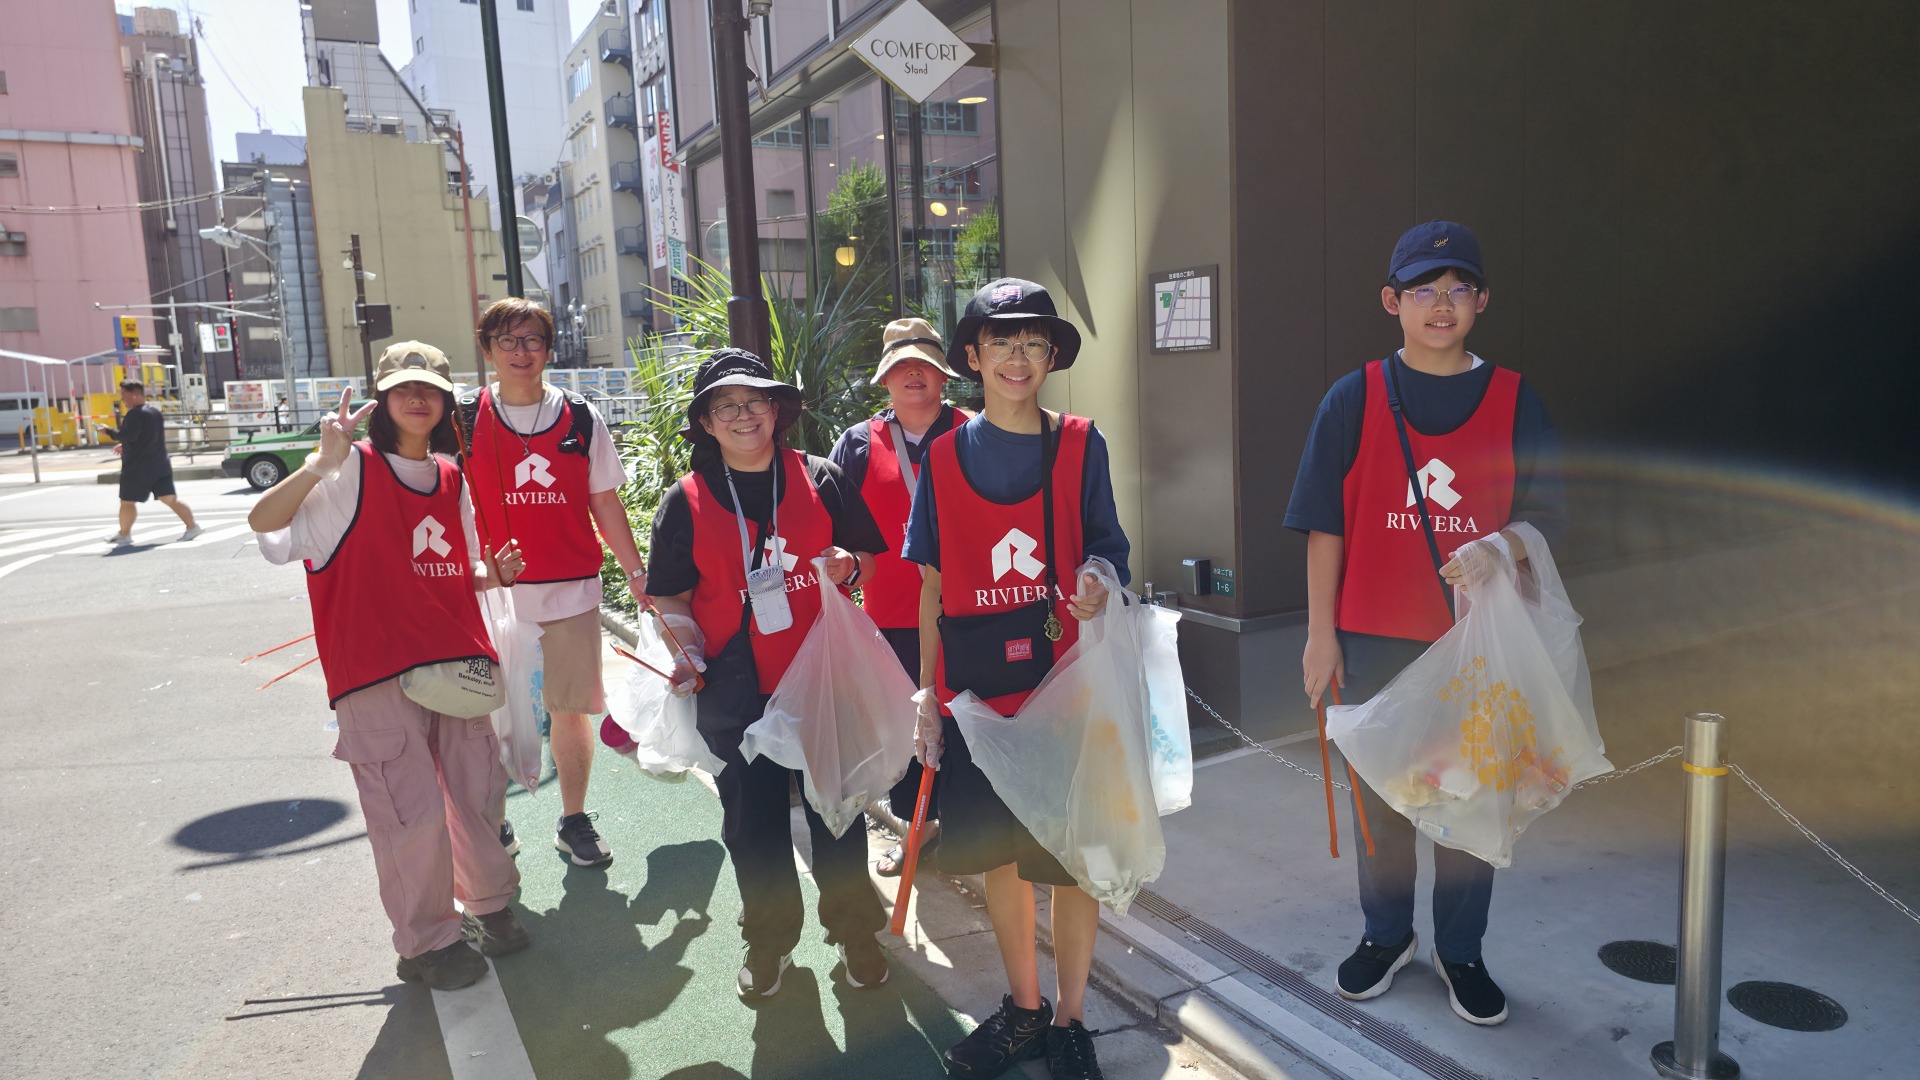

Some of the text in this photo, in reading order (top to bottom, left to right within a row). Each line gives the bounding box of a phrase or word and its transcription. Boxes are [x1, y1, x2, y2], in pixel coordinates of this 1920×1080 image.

[870, 39, 958, 61] COMFORT
[904, 62, 928, 75] Stand
[1386, 512, 1479, 533] RIVERA
[1217, 582, 1229, 592] 1-6
